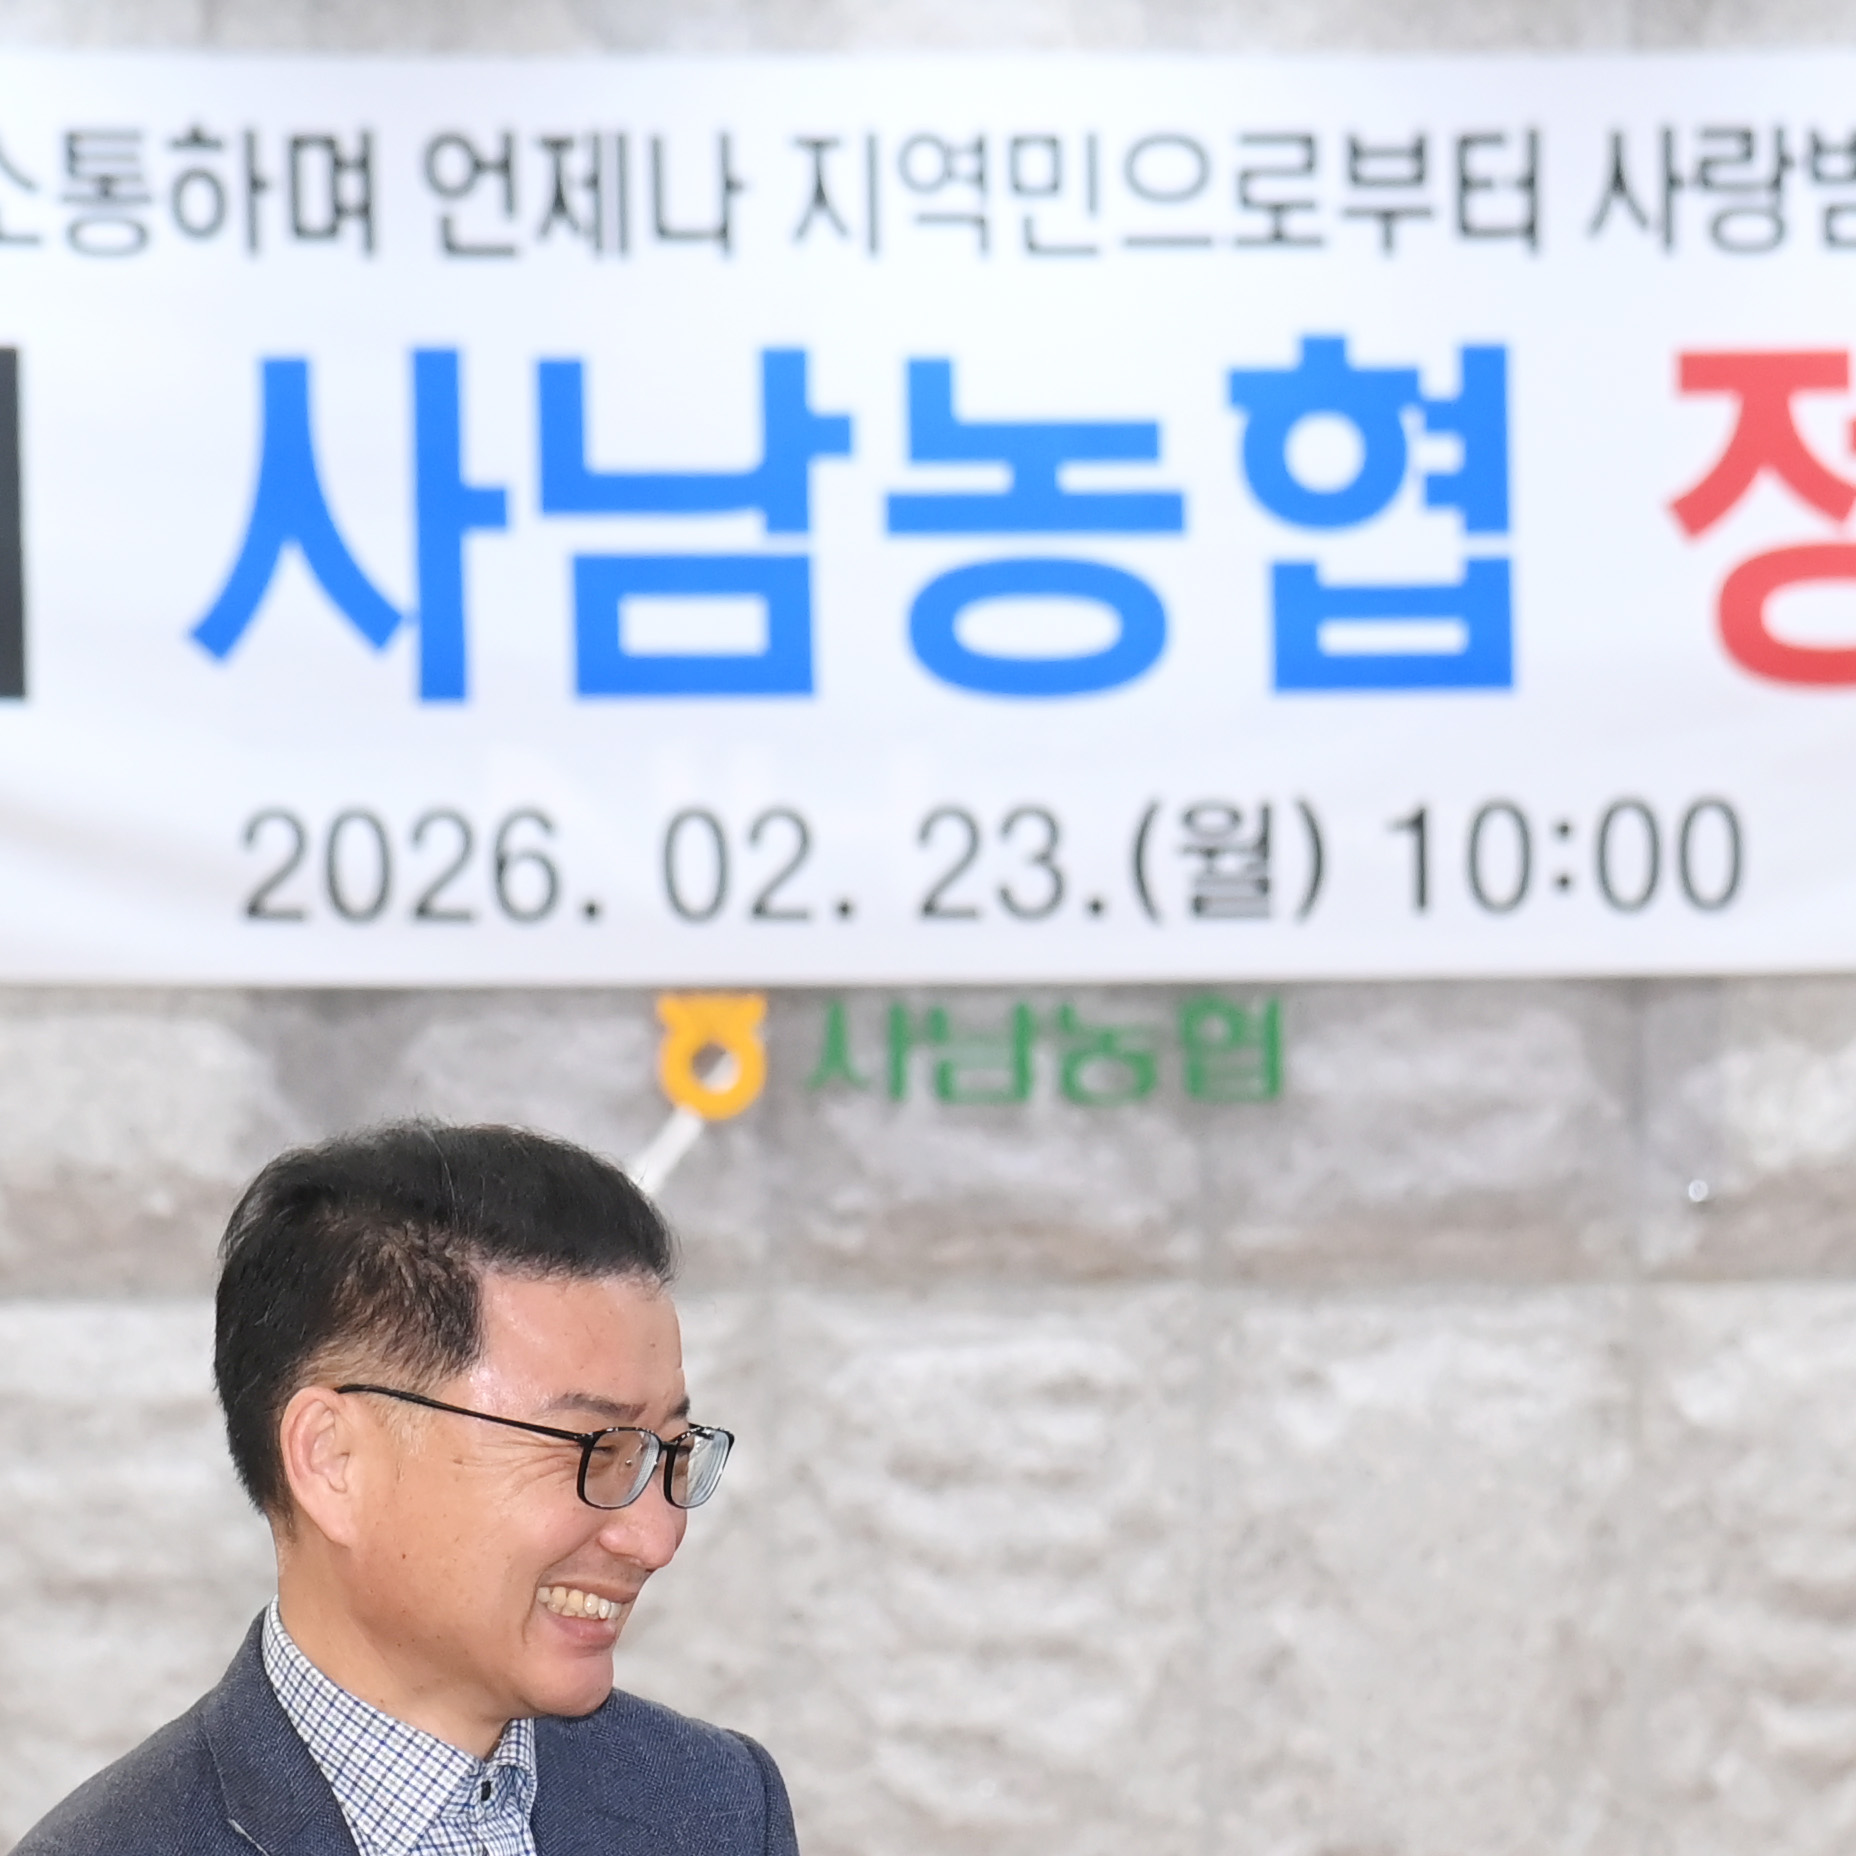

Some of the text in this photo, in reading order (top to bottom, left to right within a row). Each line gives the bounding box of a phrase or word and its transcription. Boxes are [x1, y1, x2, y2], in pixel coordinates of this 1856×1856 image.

[422, 128, 746, 257] 언제나
[792, 128, 1542, 257] 지역민으로부터
[186, 333, 1517, 706] 사남농협
[241, 796, 1747, 924] 2026. 02. 23.(월) 10:00
[804, 992, 1284, 1106] 사남농협
